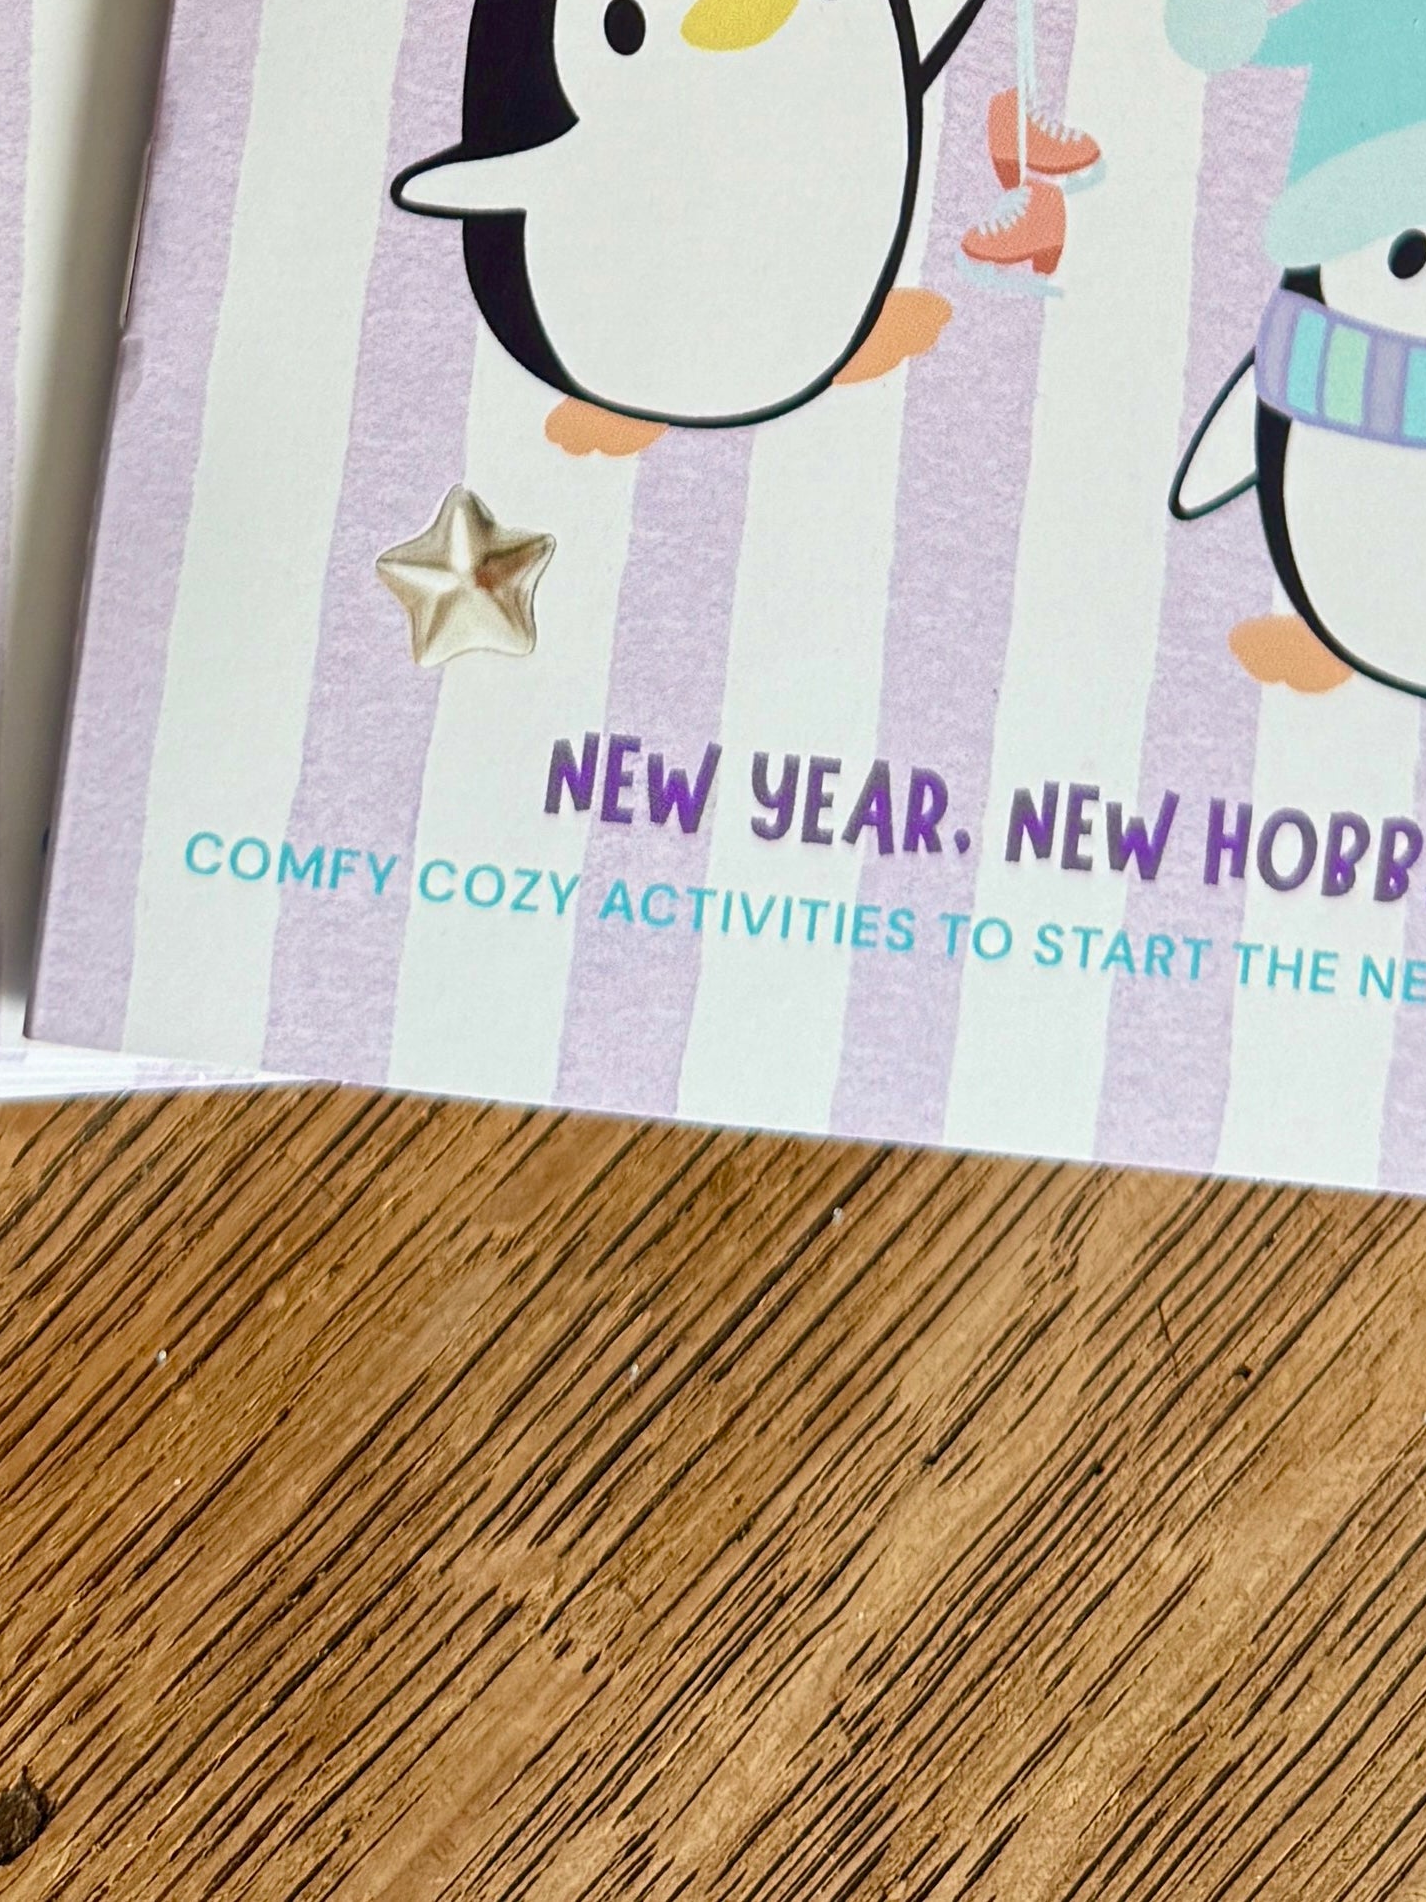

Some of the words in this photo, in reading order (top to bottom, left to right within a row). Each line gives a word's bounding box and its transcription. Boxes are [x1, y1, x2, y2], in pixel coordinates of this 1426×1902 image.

[543, 730, 723, 835] NEW
[1004, 779, 1181, 882] NEW
[182, 829, 401, 899] COMFY
[416, 858, 582, 919] COZY
[595, 877, 918, 956] ACTIVITIES
[936, 911, 1015, 965] TO
[1031, 921, 1215, 983] START
[1230, 940, 1340, 997] THE
